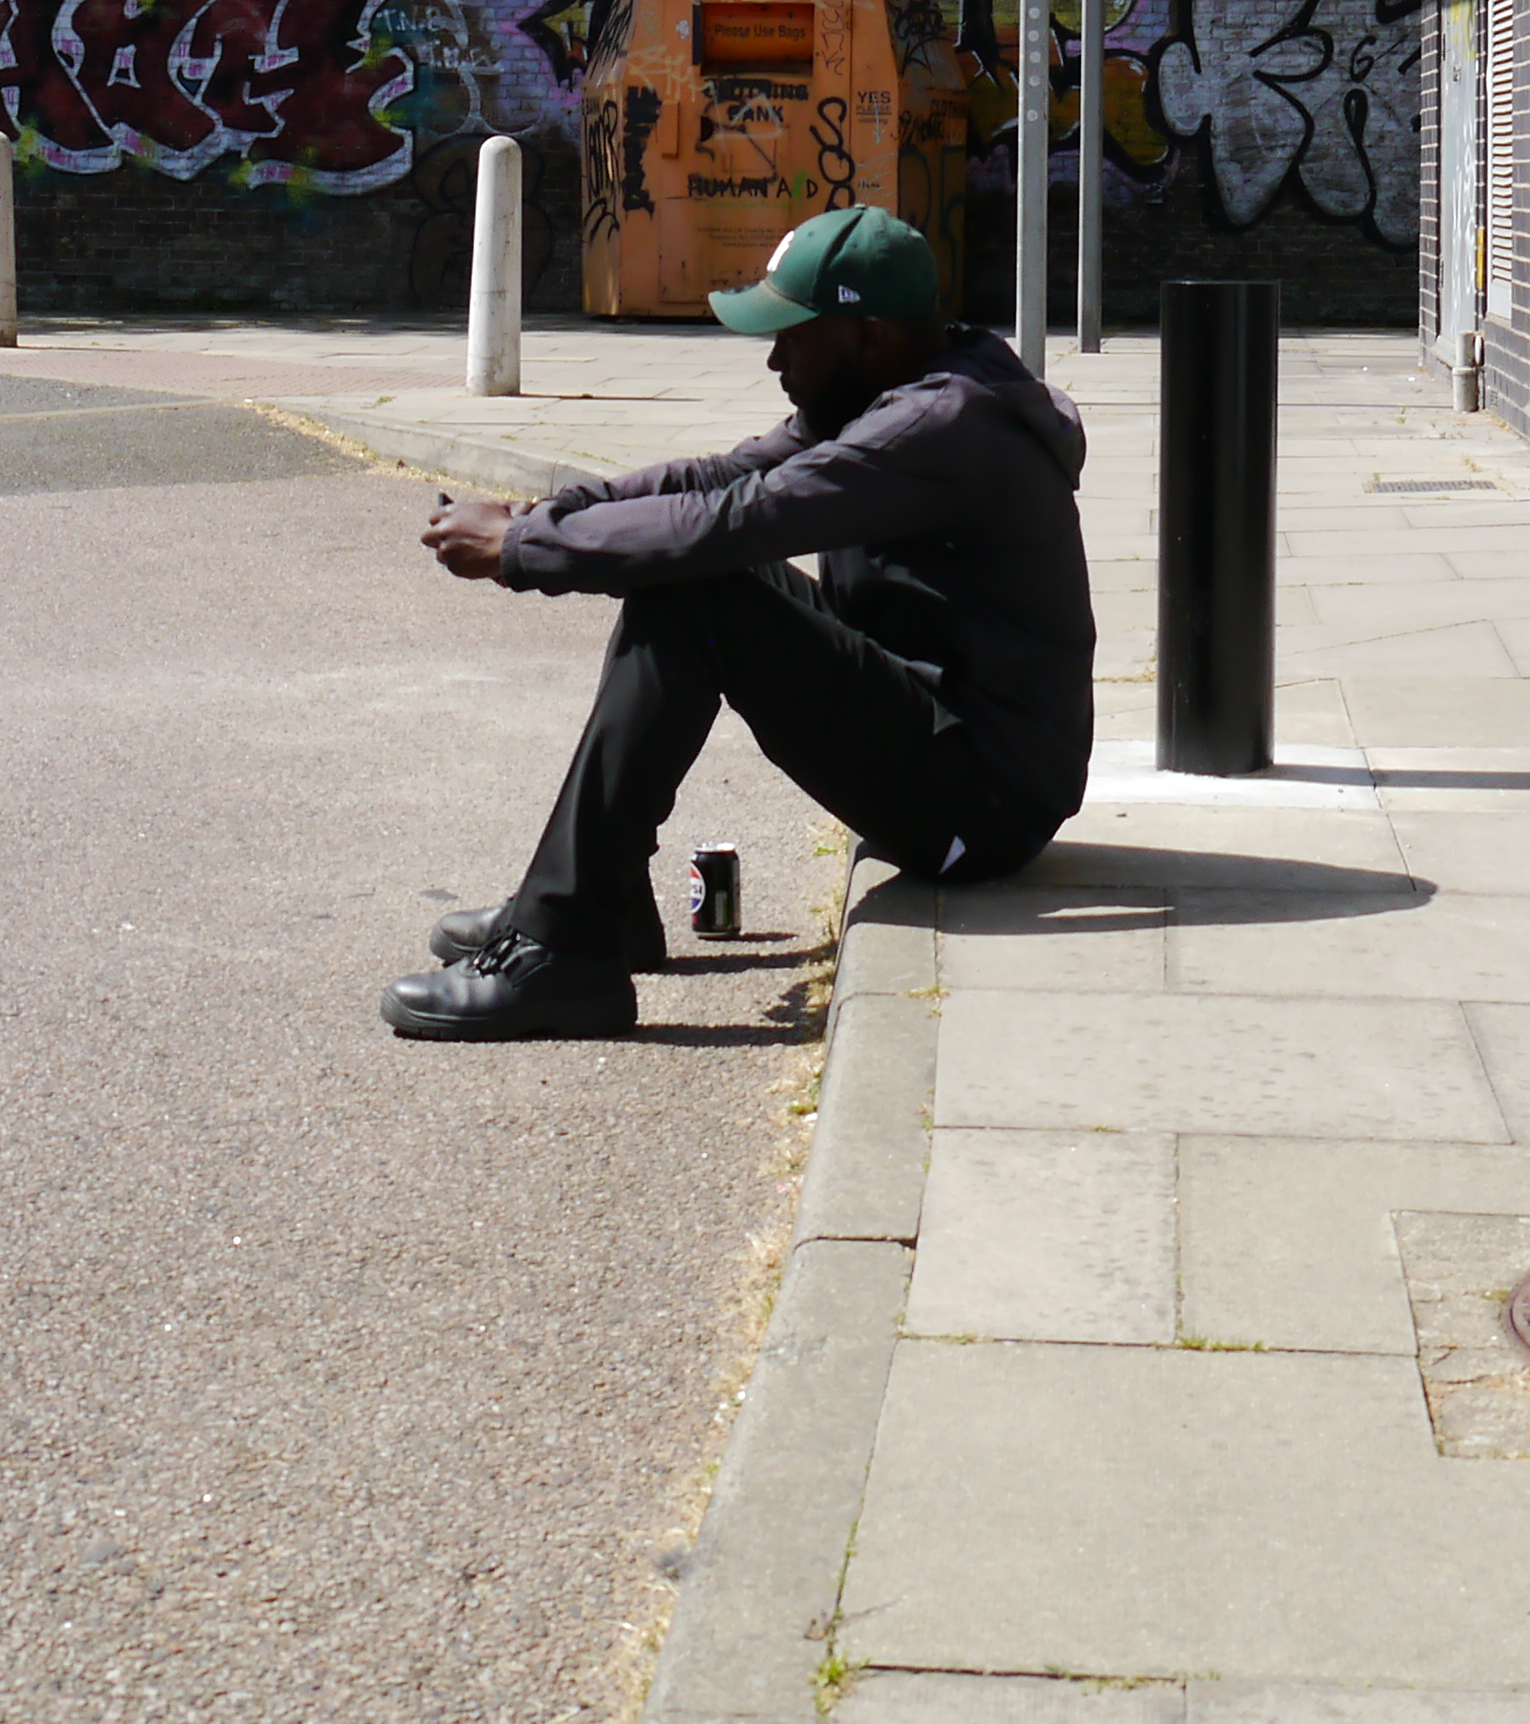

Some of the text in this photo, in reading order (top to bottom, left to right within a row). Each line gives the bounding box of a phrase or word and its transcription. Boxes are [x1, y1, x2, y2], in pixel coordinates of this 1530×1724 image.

[715, 24, 807, 40] Please Use Bags
[857, 91, 891, 104] YES
